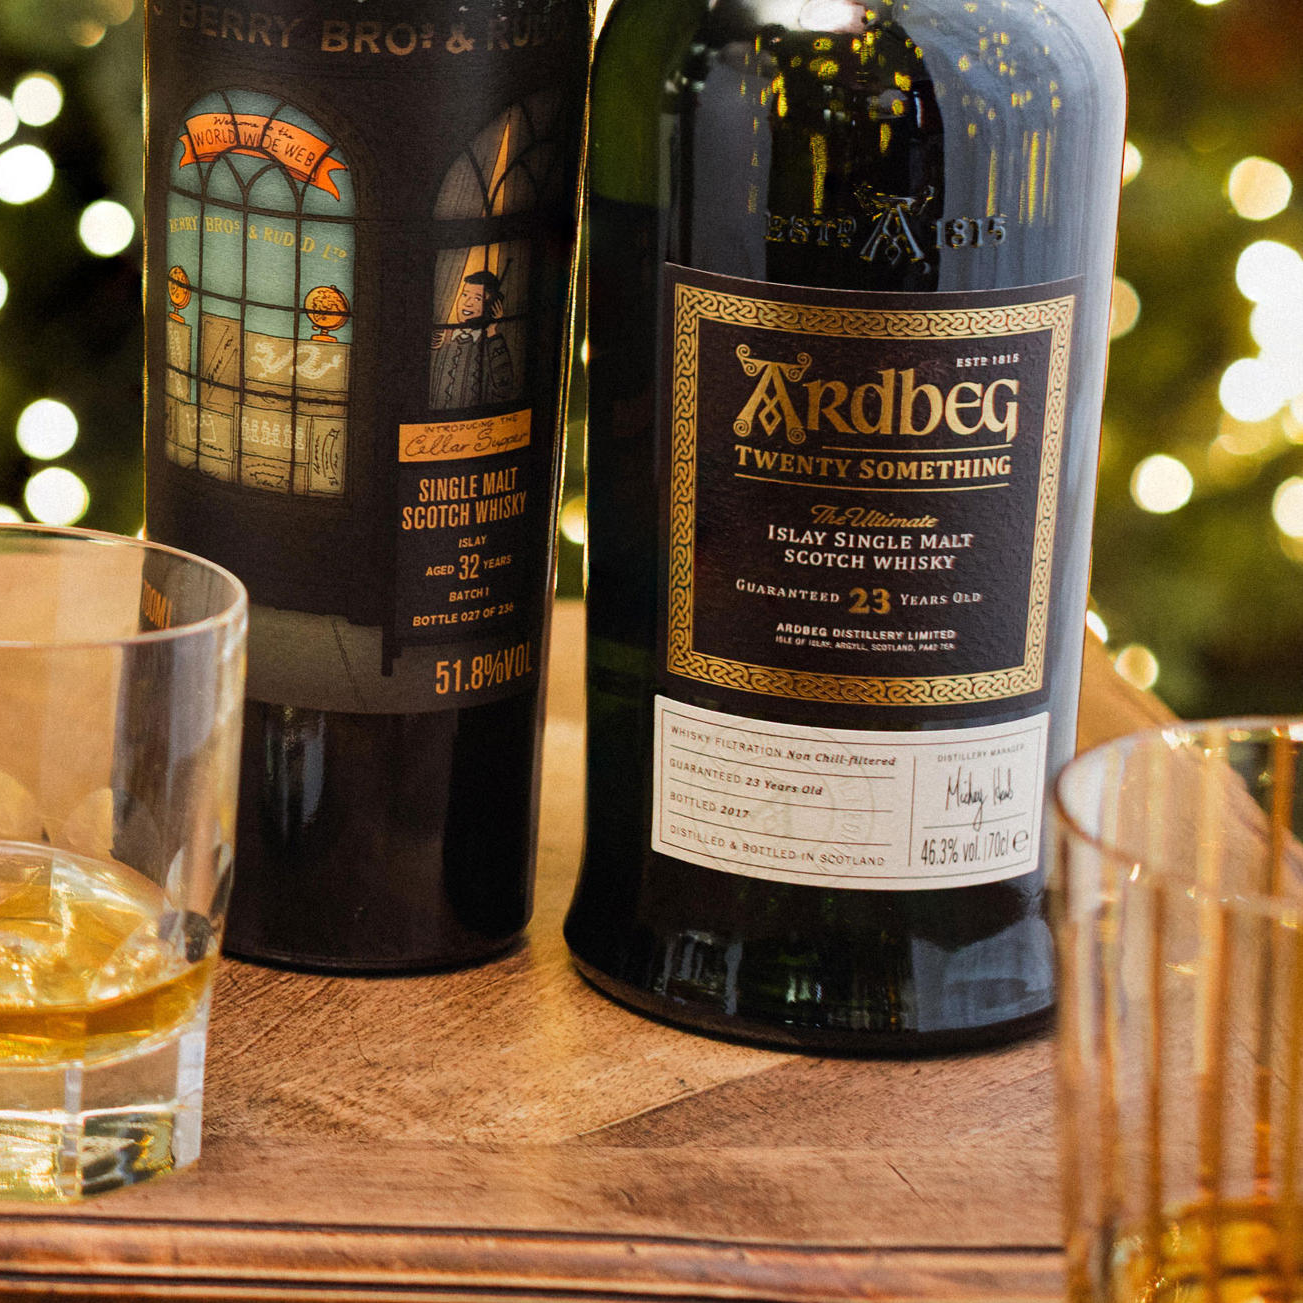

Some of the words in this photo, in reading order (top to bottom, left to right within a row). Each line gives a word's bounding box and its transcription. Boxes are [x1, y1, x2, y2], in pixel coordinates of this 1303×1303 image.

[445, 22, 475, 54] &
[193, 128, 237, 147] WORLD
[241, 131, 281, 153] WIDE
[284, 144, 316, 167] WEB
[248, 224, 258, 240] &
[263, 224, 315, 253] RUDD
[992, 353, 1020, 365] 1815
[734, 444, 852, 479] TWENTY
[860, 455, 1013, 482] SOMETHING
[419, 475, 478, 502] SINGLE
[483, 467, 518, 496] MALT
[401, 502, 470, 530] SCOTCH
[475, 491, 527, 524] WHISKY
[810, 504, 846, 526] The
[846, 507, 939, 528] Ultimate
[458, 535, 487, 548] ISLAY
[834, 531, 913, 550] SINGLE
[920, 533, 975, 549] MALT
[425, 565, 455, 577] AGED
[458, 554, 480, 580] 32
[483, 554, 512, 569] YEARS
[784, 549, 865, 569] SCOTCH
[873, 555, 957, 571] WHISKY
[449, 588, 483, 602] BATCH
[848, 587, 892, 615] 23
[412, 613, 458, 627] BOTTLE
[460, 610, 481, 622] 027
[483, 607, 496, 618] OF
[776, 623, 827, 637] ARDBEG
[832, 628, 905, 641] DISTILLERY
[908, 629, 957, 642] LIMITED
[671, 725, 711, 745] WHISKY
[715, 737, 782, 758] FILTRATION
[786, 749, 811, 761] Non
[815, 753, 897, 767] Chill-filtered
[669, 758, 742, 784] GUARANTEED
[745, 776, 760, 787] 23
[764, 780, 798, 793] Years
[802, 785, 824, 796] Old
[669, 792, 717, 812] BOTTLED
[720, 805, 750, 819] 2017
[669, 825, 725, 848] DISTILLED
[729, 840, 737, 850] &
[742, 843, 796, 860] BOTTLED
[819, 853, 886, 866] SCOTLAND
